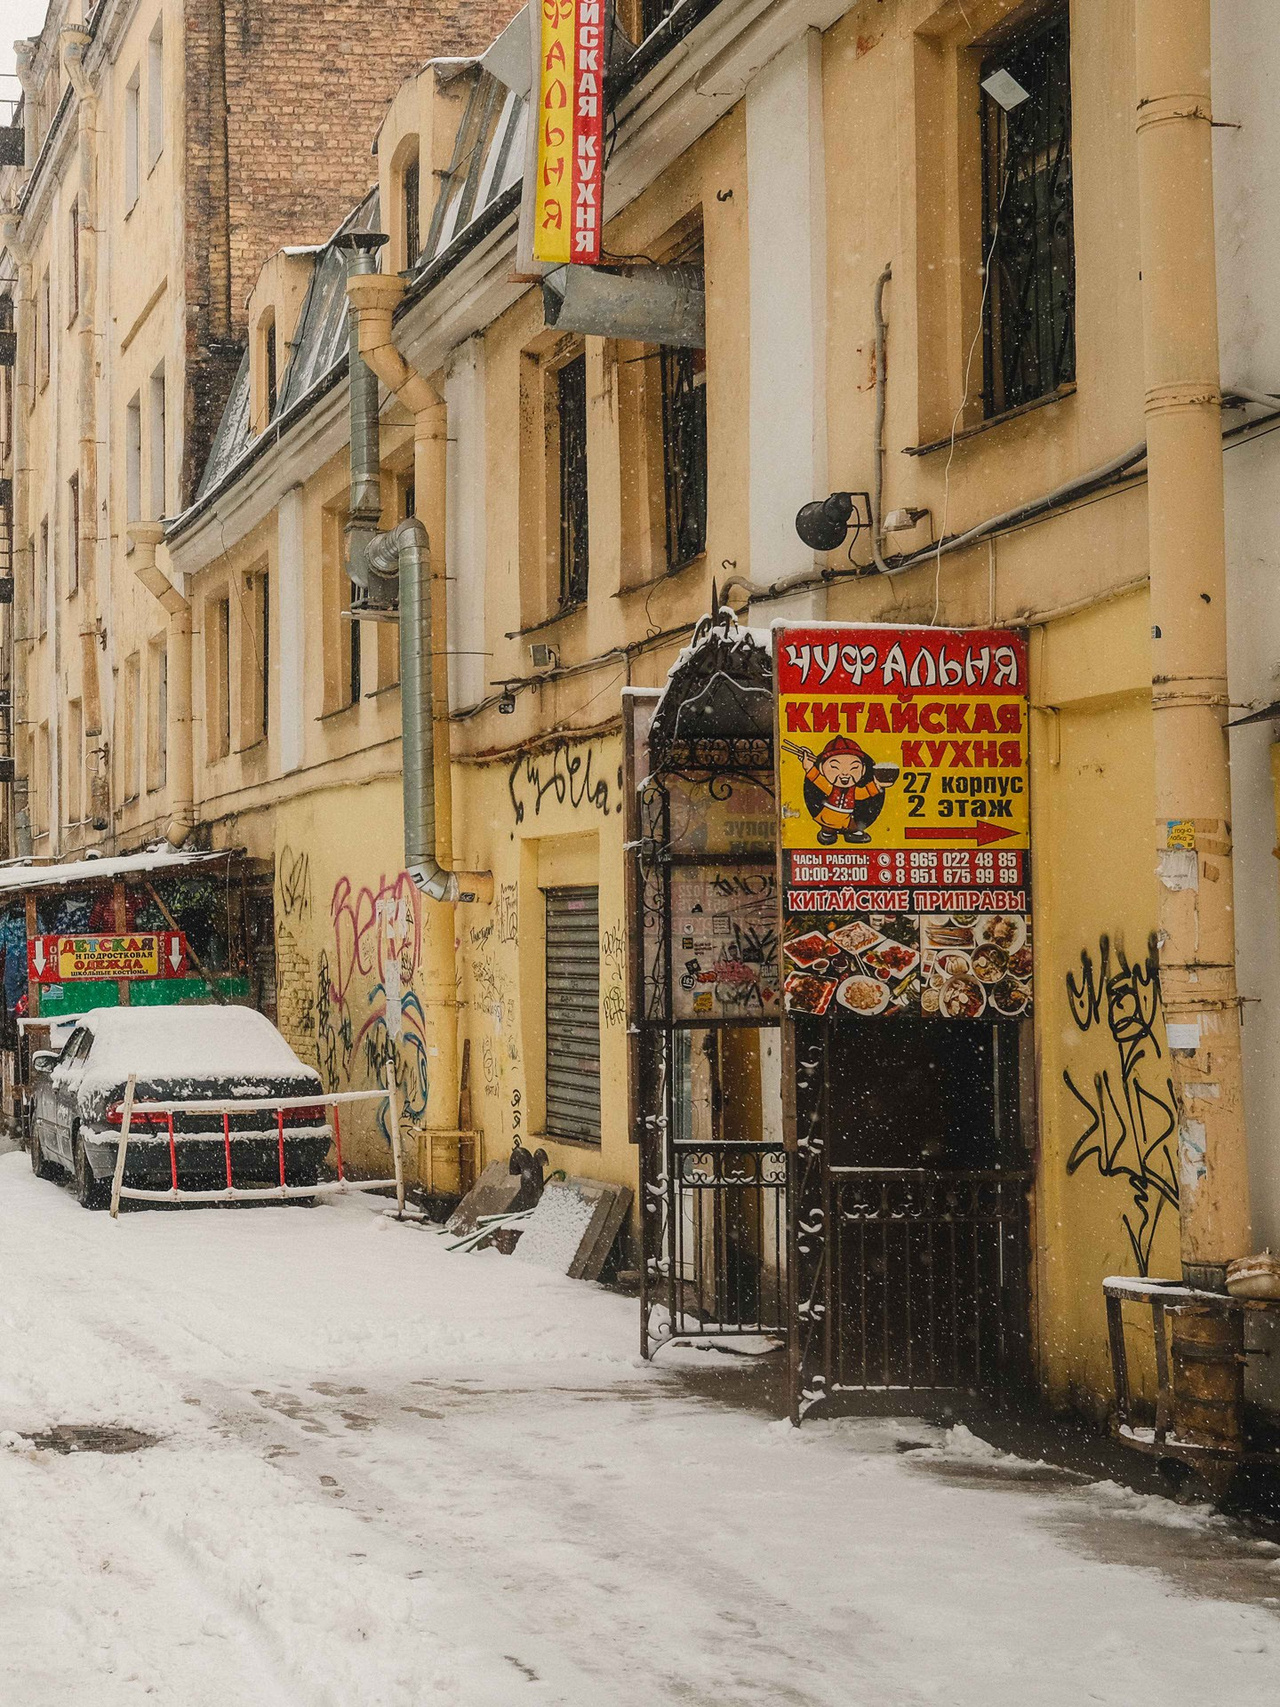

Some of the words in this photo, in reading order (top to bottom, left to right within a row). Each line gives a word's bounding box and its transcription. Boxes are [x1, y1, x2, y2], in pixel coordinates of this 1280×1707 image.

[575, 135, 597, 252] КУХНЯ
[785, 641, 1019, 687] ЧУФАЛЬНЯ
[785, 692, 1022, 734] КИТАЙСКАЯ
[900, 740, 1022, 768] КУХНЯ
[903, 772, 931, 794] 27
[942, 776, 1023, 797] корпус
[908, 795, 925, 818] 2
[937, 799, 1013, 818] этаж
[793, 854, 822, 865] ЧАСЫ
[826, 854, 870, 865] РАБОТЫ:
[895, 852, 905, 867] 8
[910, 852, 937, 867] 965
[943, 852, 970, 867] 022
[975, 852, 993, 867] 48
[998, 852, 1017, 867] 85
[794, 867, 868, 882] 10:00-23:00
[895, 869, 905, 884] 8
[910, 869, 937, 884] 951
[943, 869, 970, 884] 675
[976, 869, 994, 884] 99
[999, 869, 1018, 884] 99
[788, 887, 910, 911] КИТАЙСКИЕ
[914, 890, 1026, 911] ПРИПРАВЫ
[60, 938, 154, 955] ДЕТСКАЯ
[84, 951, 153, 960] ПОДРОСТКОВАЯ
[74, 959, 143, 971] ОДЕЖДА
